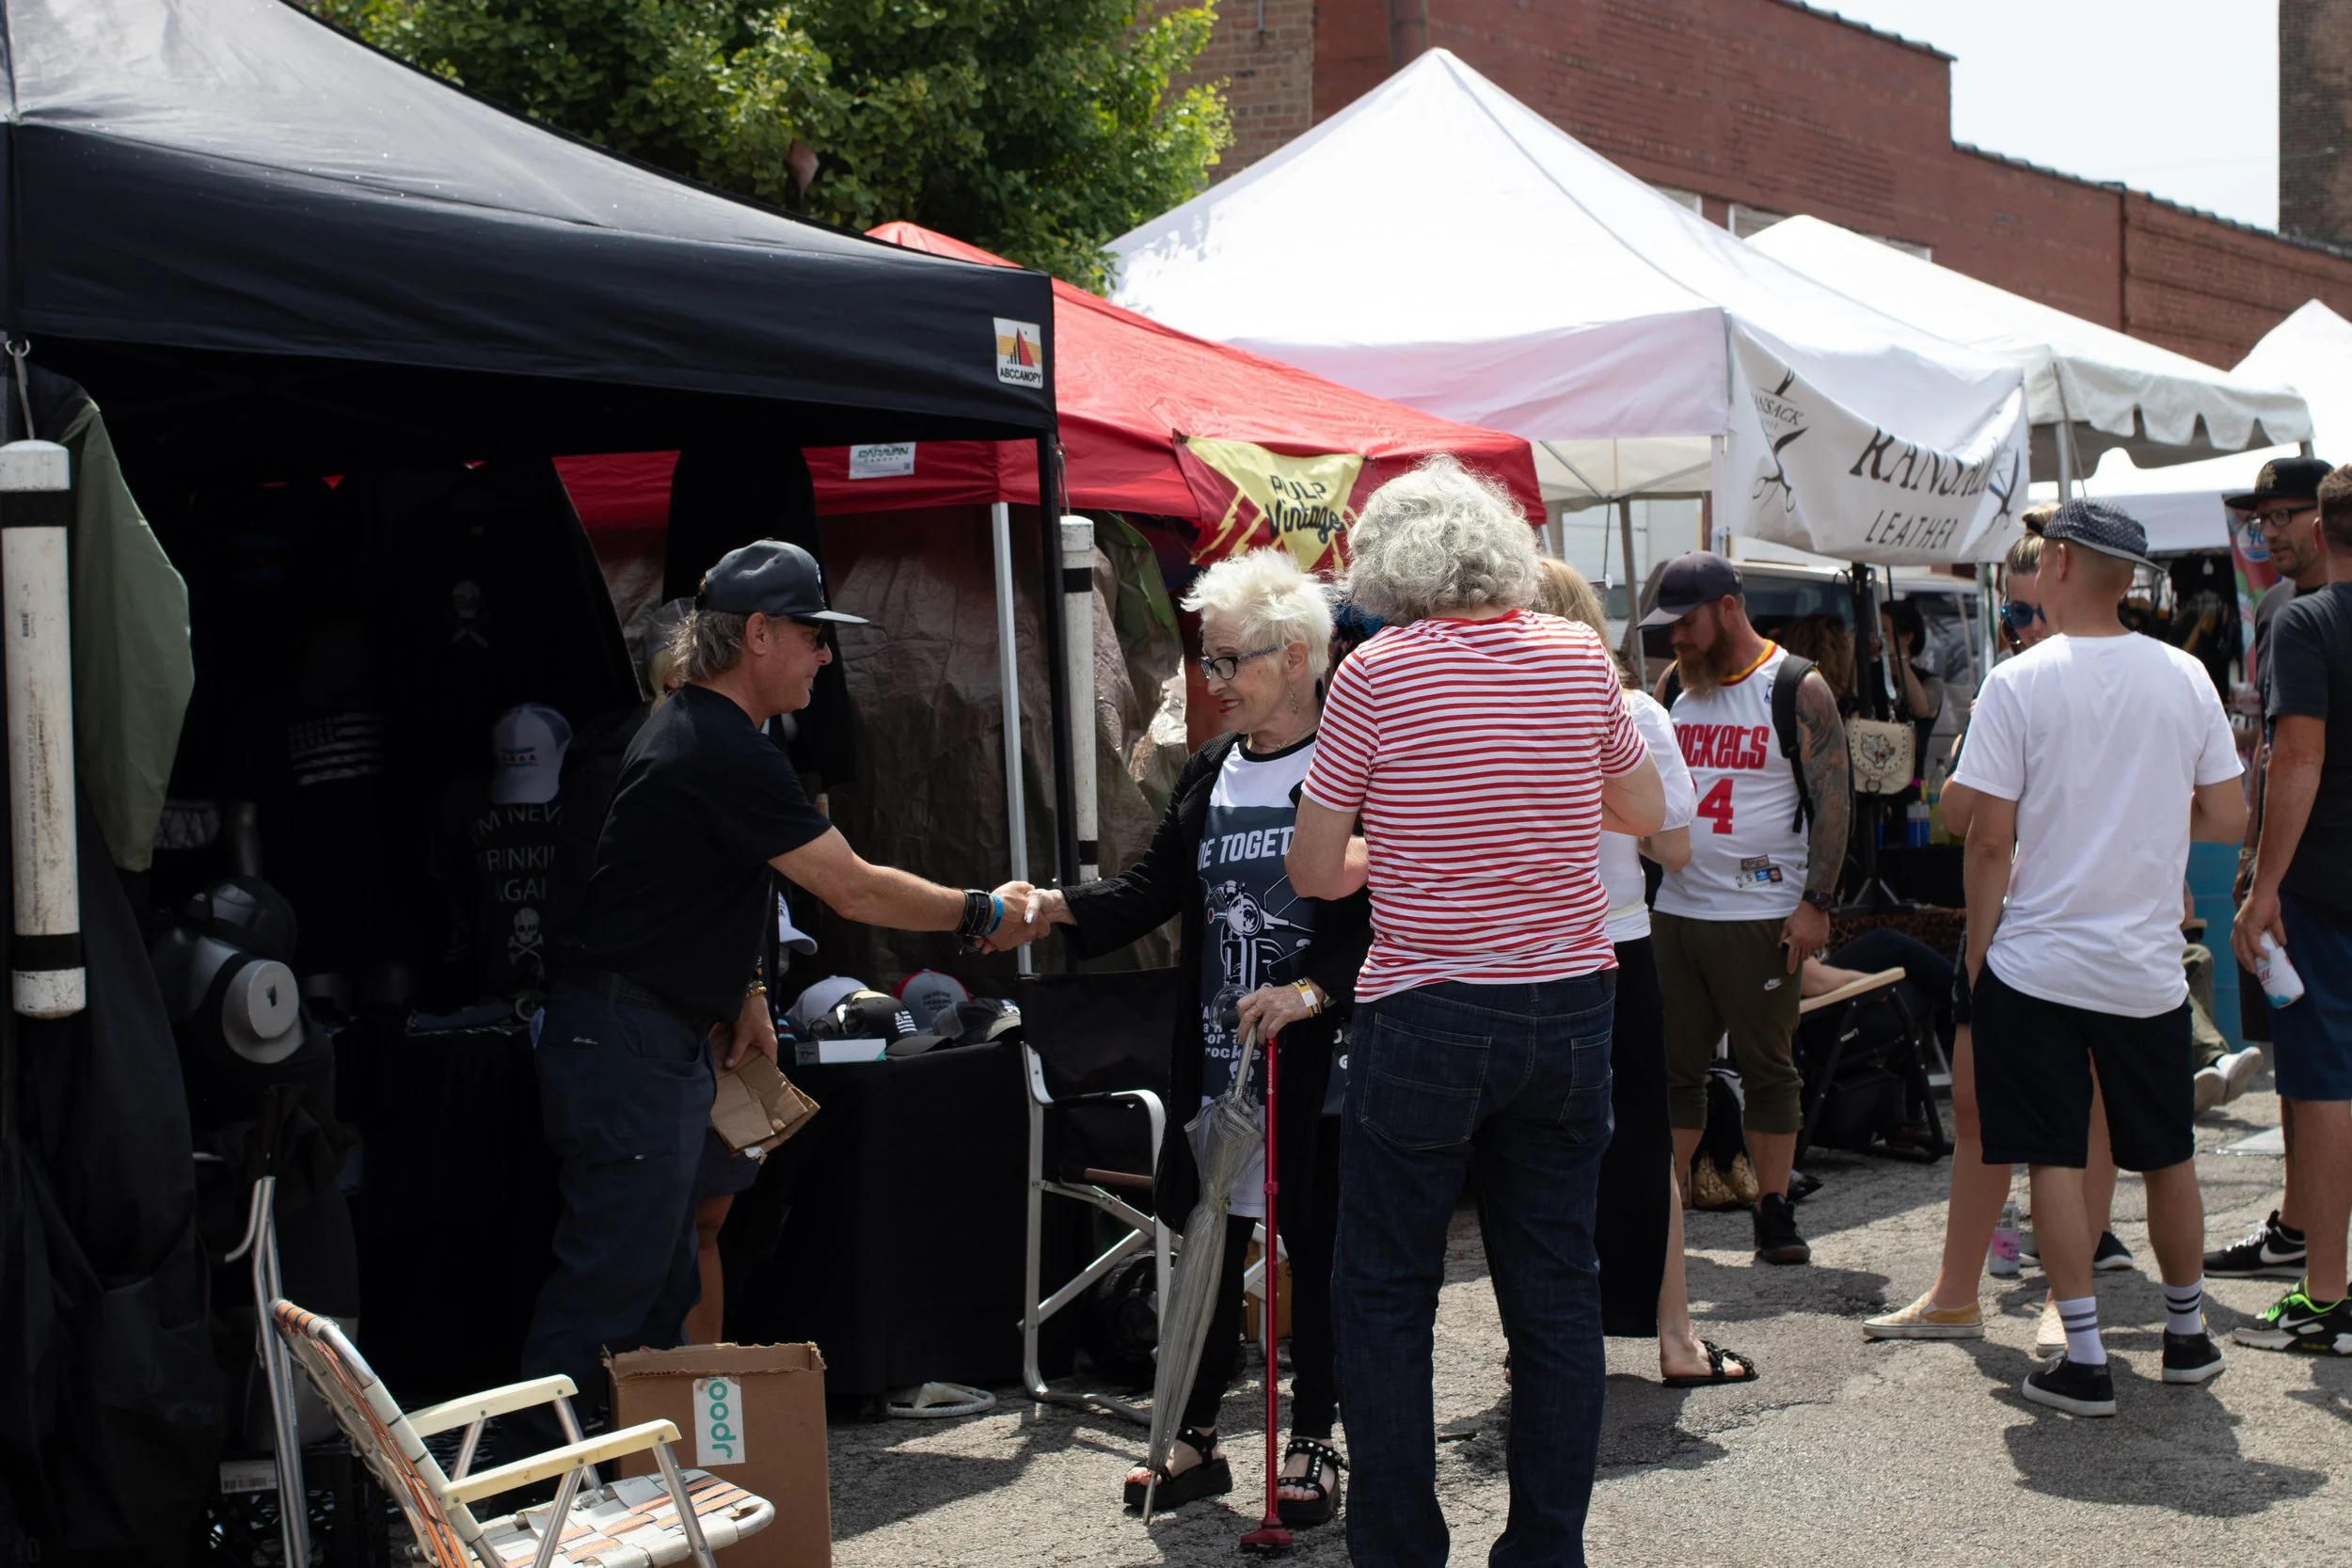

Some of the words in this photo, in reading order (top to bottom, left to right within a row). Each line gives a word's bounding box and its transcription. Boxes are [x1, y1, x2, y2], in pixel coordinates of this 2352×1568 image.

[999, 367, 1043, 384] ABCCANOPY
[1269, 474, 1327, 500] PULP
[1264, 498, 1346, 545] Vintage
[1865, 509, 1959, 549] LEATHER
[1675, 723, 1770, 770] OCKETS
[507, 801, 564, 826] NEV
[1692, 774, 1734, 835] 4
[1219, 826, 1295, 864] TOGET
[707, 1376, 737, 1460] oodr
